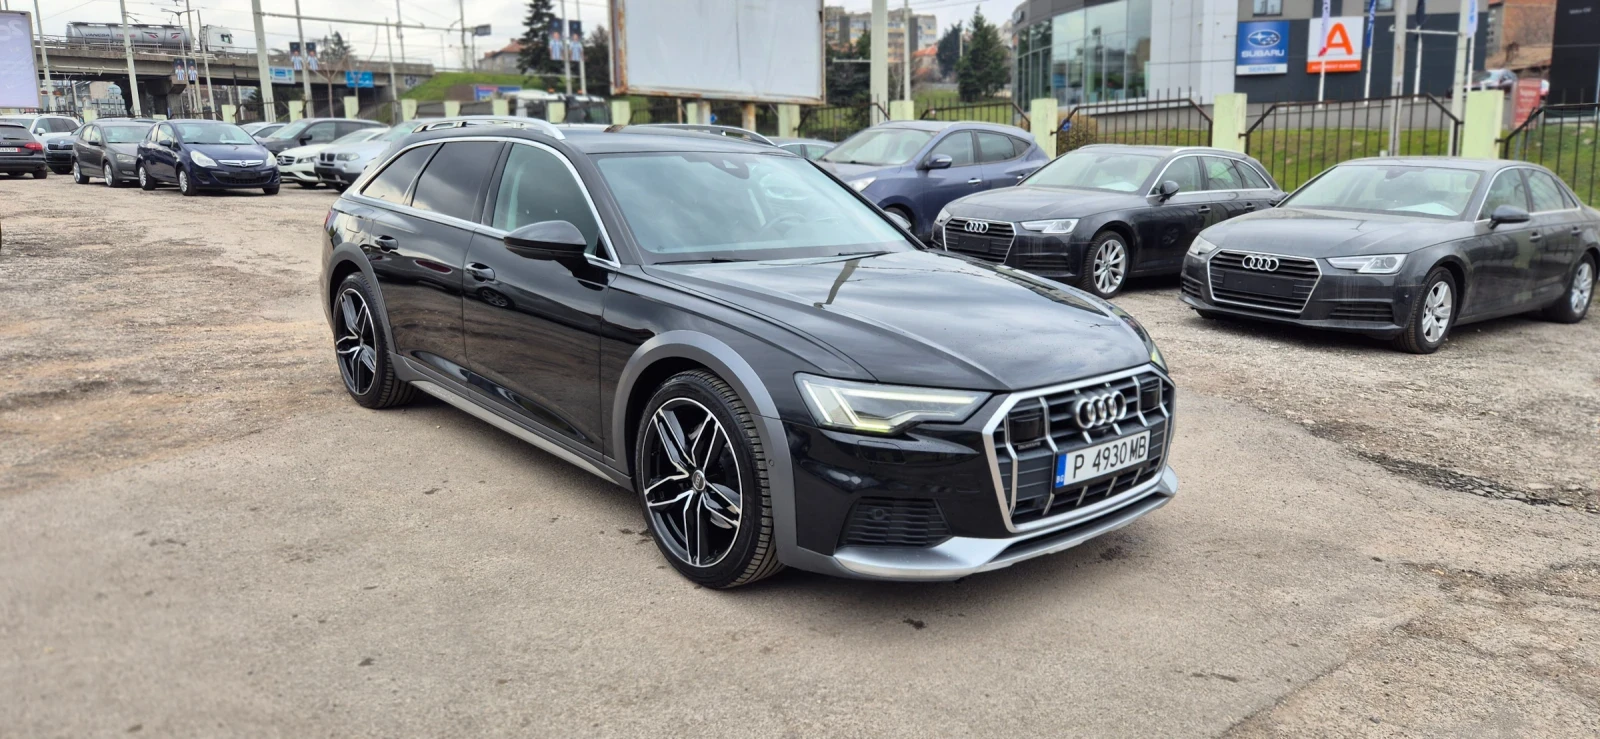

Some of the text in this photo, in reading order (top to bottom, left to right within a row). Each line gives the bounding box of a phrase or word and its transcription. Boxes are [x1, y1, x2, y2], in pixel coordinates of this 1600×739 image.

[1241, 49, 1285, 58] SUBARU
[1325, 21, 1354, 56] A
[1073, 435, 1147, 479] P 4930 MB
